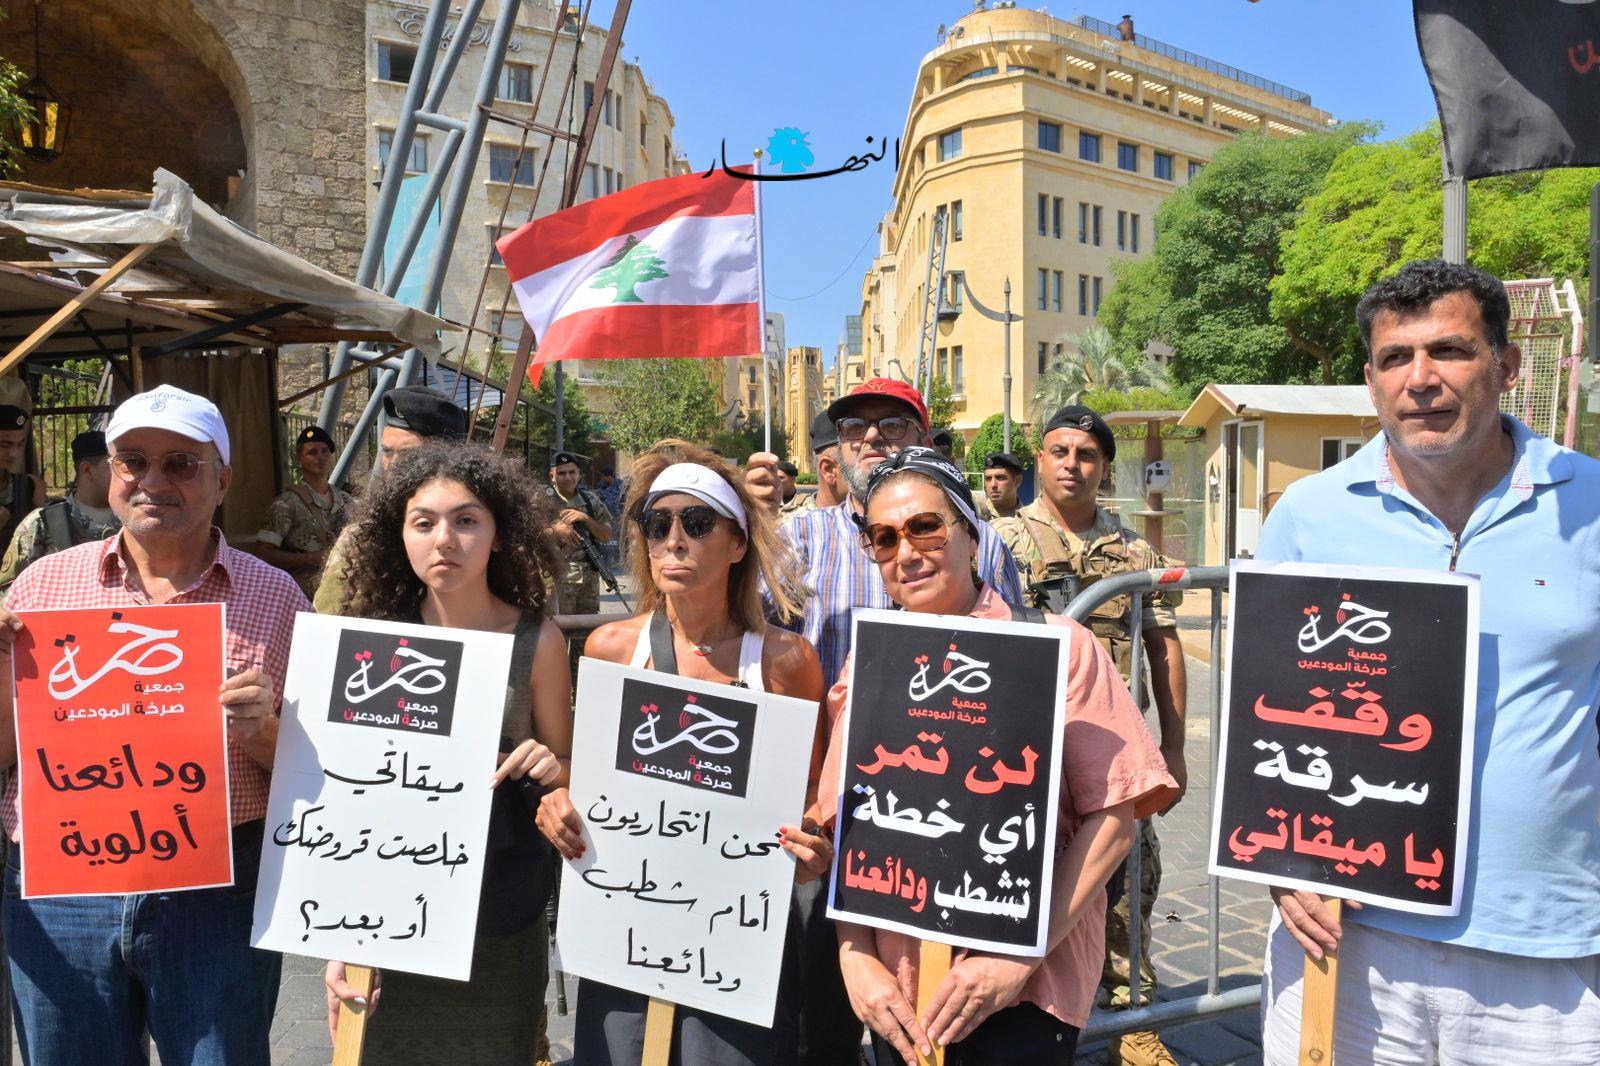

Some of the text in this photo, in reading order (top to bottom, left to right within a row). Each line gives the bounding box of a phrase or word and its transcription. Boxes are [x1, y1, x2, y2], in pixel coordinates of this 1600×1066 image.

[1298, 658, 1388, 676] صرخة المودعين
[1347, 648, 1388, 663] جمعية
[54, 701, 185, 722] صرخة المودعين
[134, 680, 185, 694] جمعية
[397, 698, 438, 714] جمعية
[951, 697, 987, 711] جمعية
[343, 708, 438, 730] صرخة المودعين
[908, 707, 987, 724] صرخة المودعين
[36, 743, 206, 794] ودائعنا
[323, 750, 464, 801] ميقاتي
[632, 758, 733, 791] صرخة المودعين
[688, 755, 732, 775] جمعية
[855, 731, 1040, 795] لن تمر
[1253, 739, 1430, 806] سرقة
[60, 803, 199, 867] أولوية
[273, 805, 469, 878] خلصت قروضك
[587, 794, 711, 845] انتحاريون
[852, 783, 1036, 865] أي خطة
[1228, 807, 1444, 891] يا ميقاتي
[581, 858, 770, 935] أمام شطب
[844, 848, 1032, 921] تشطب ودائعنا
[389, 893, 427, 940] أو
[626, 927, 741, 992] ودائعنا
